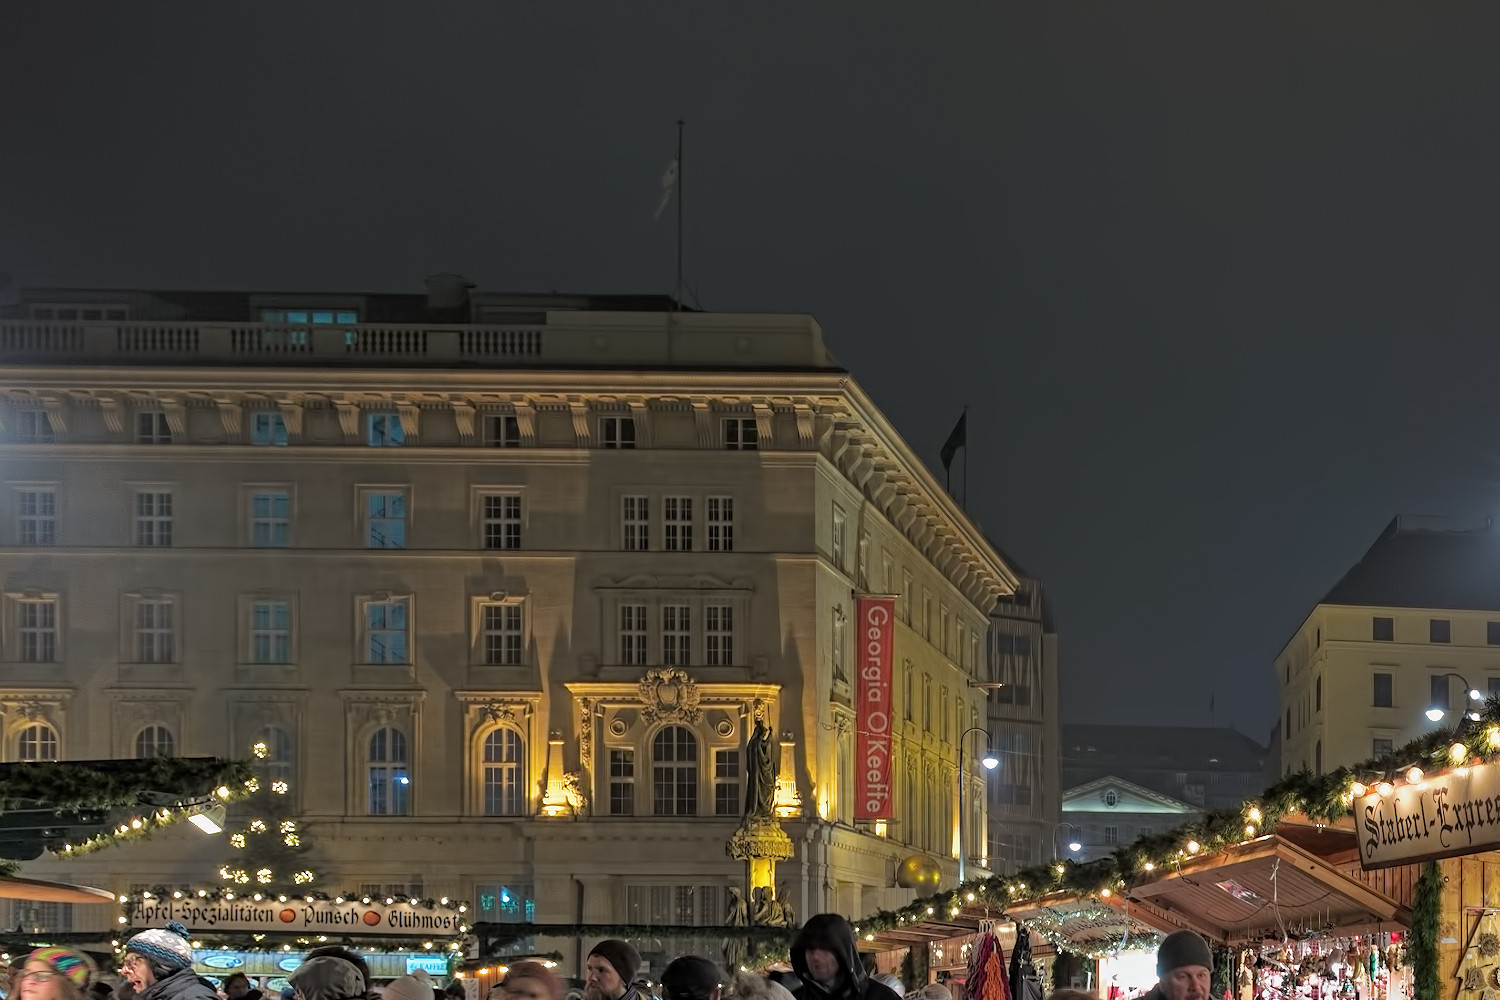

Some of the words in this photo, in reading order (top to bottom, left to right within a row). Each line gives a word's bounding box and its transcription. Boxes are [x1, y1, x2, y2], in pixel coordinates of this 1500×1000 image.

[862, 605, 889, 702] Georgia
[866, 711, 889, 813] O'Keeffe
[134, 902, 275, 926] Apfel-Spezialitäten
[301, 904, 360, 928] Punsch
[387, 902, 459, 929] Glühmost
